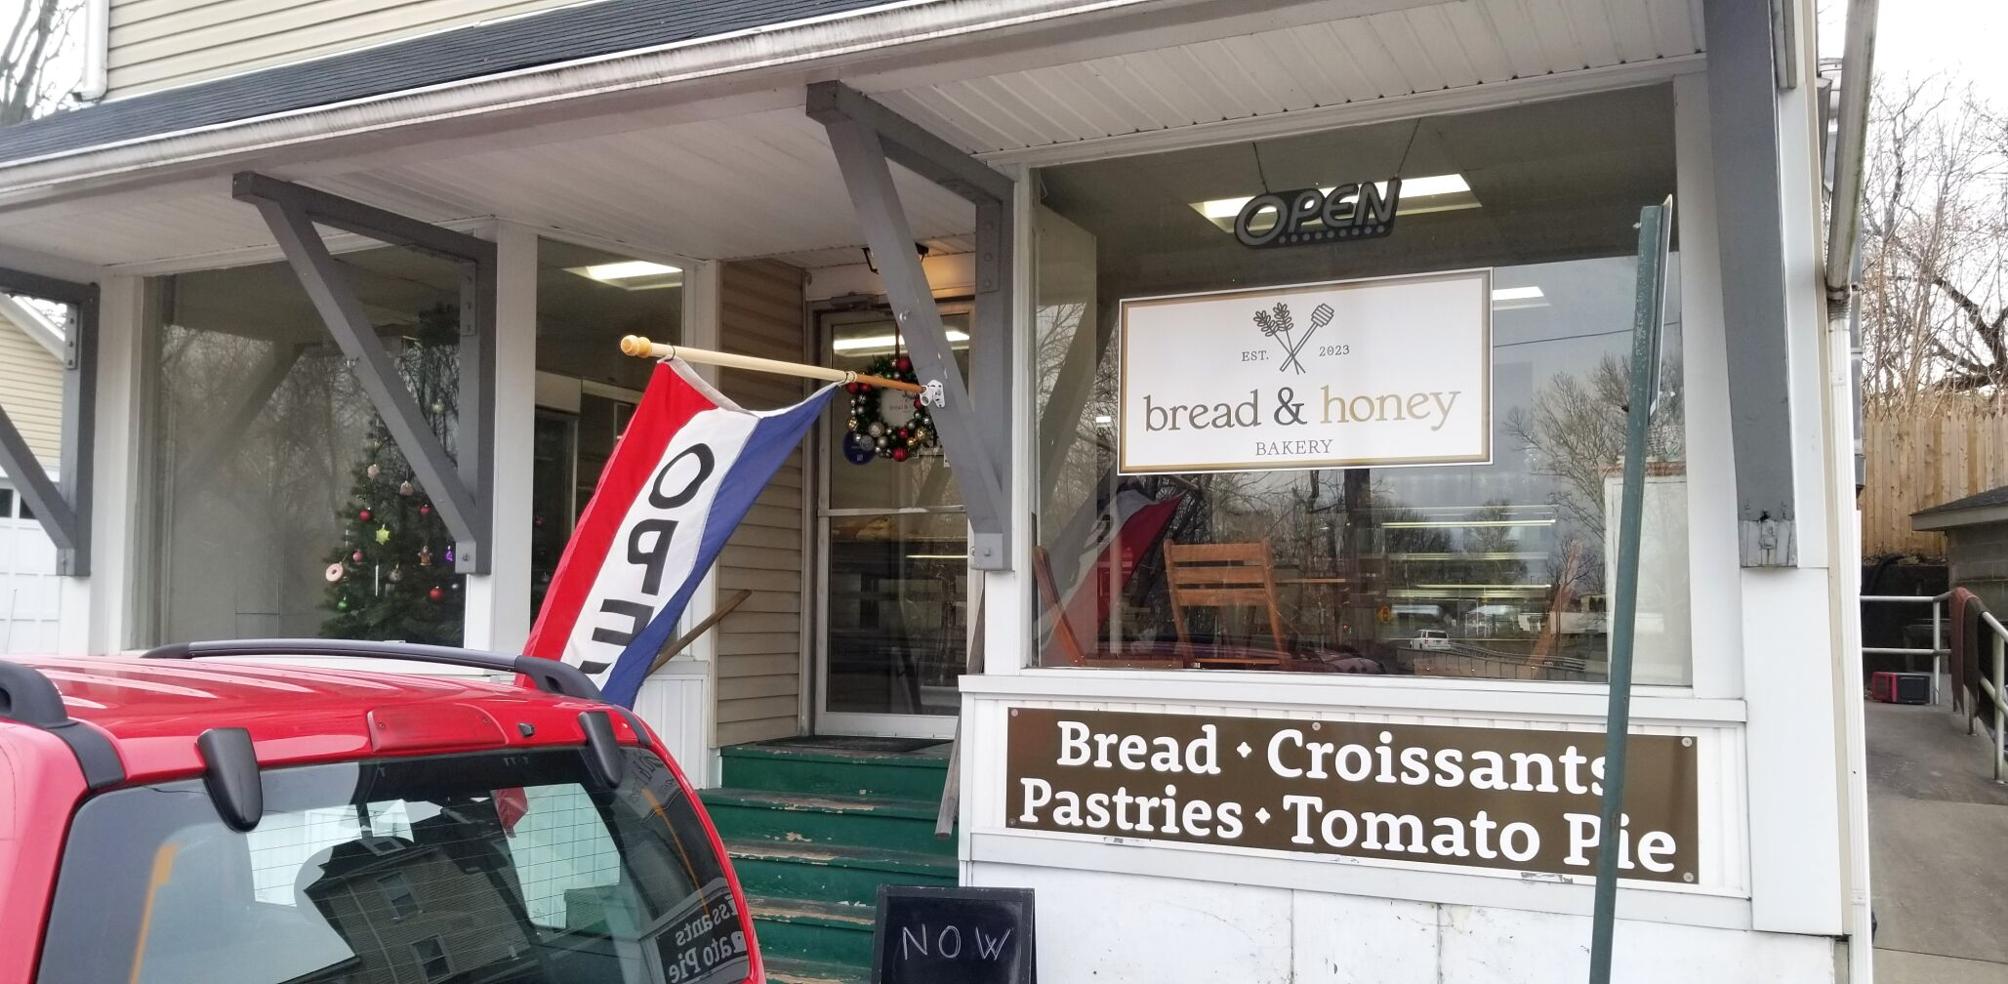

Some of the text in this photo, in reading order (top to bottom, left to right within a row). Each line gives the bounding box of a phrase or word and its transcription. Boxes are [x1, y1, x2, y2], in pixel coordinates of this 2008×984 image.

[1235, 176, 1402, 247] OPEN
[1241, 344, 1351, 363] EST. 2023
[1143, 385, 1462, 432] bread & honey
[1255, 439, 1334, 457] BAKERY
[1056, 720, 1222, 776] Bread
[1019, 777, 1677, 873] Pastries Tomato Pie
[901, 923, 1012, 961] NOW
